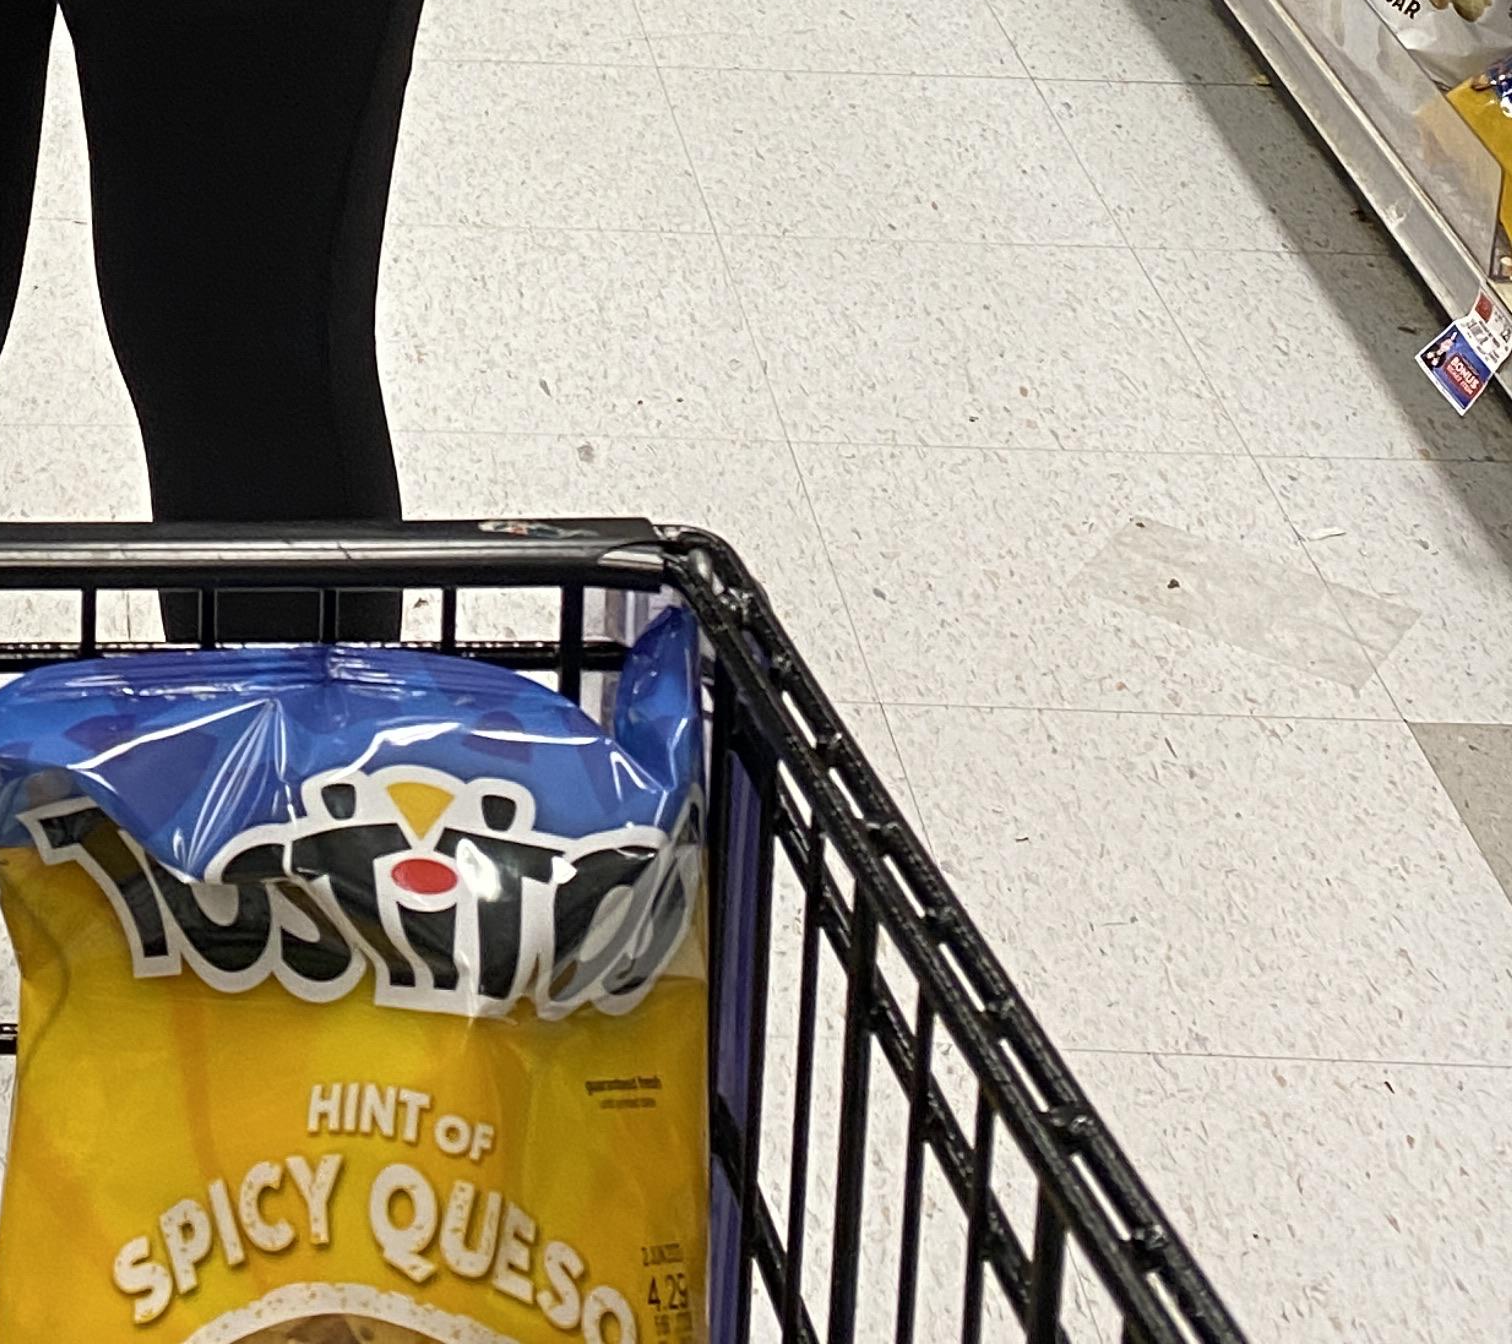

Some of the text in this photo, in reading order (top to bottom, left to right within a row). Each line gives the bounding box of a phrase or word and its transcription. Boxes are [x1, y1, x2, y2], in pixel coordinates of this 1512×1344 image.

[306, 1081, 495, 1163] HINT OF
[112, 1153, 639, 1344] SPICY QUESO
